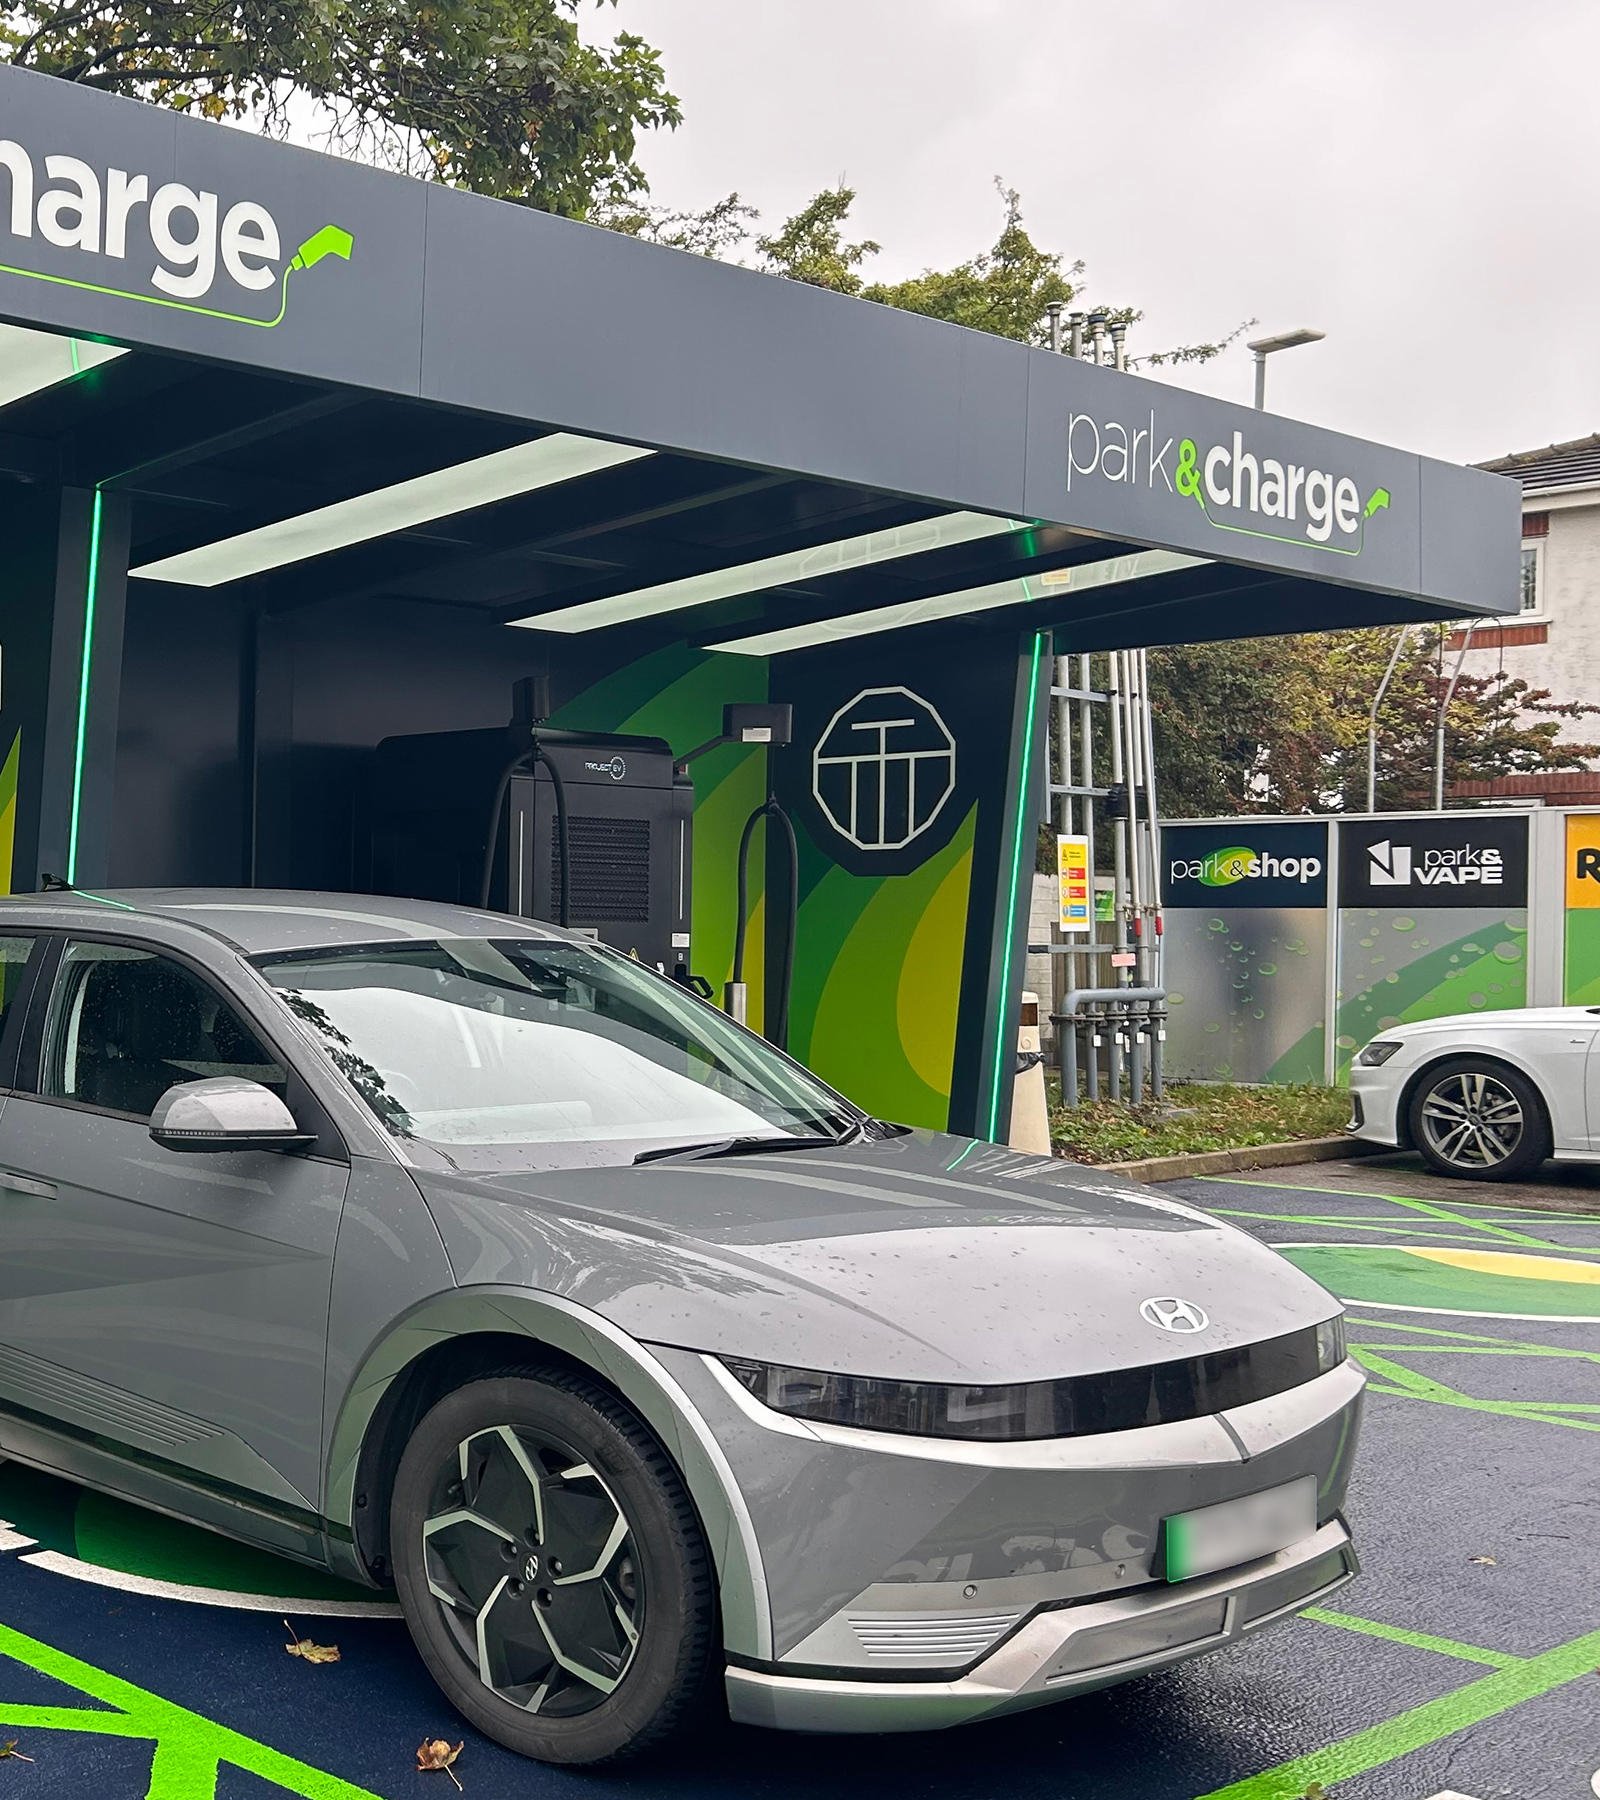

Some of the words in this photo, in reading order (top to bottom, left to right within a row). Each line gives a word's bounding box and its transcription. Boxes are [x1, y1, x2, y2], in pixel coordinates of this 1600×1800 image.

[1066, 409, 1360, 541] park&charge
[1170, 852, 1322, 885] park&shop
[1424, 843, 1503, 871] park&
[1414, 866, 1503, 885] VAPE
